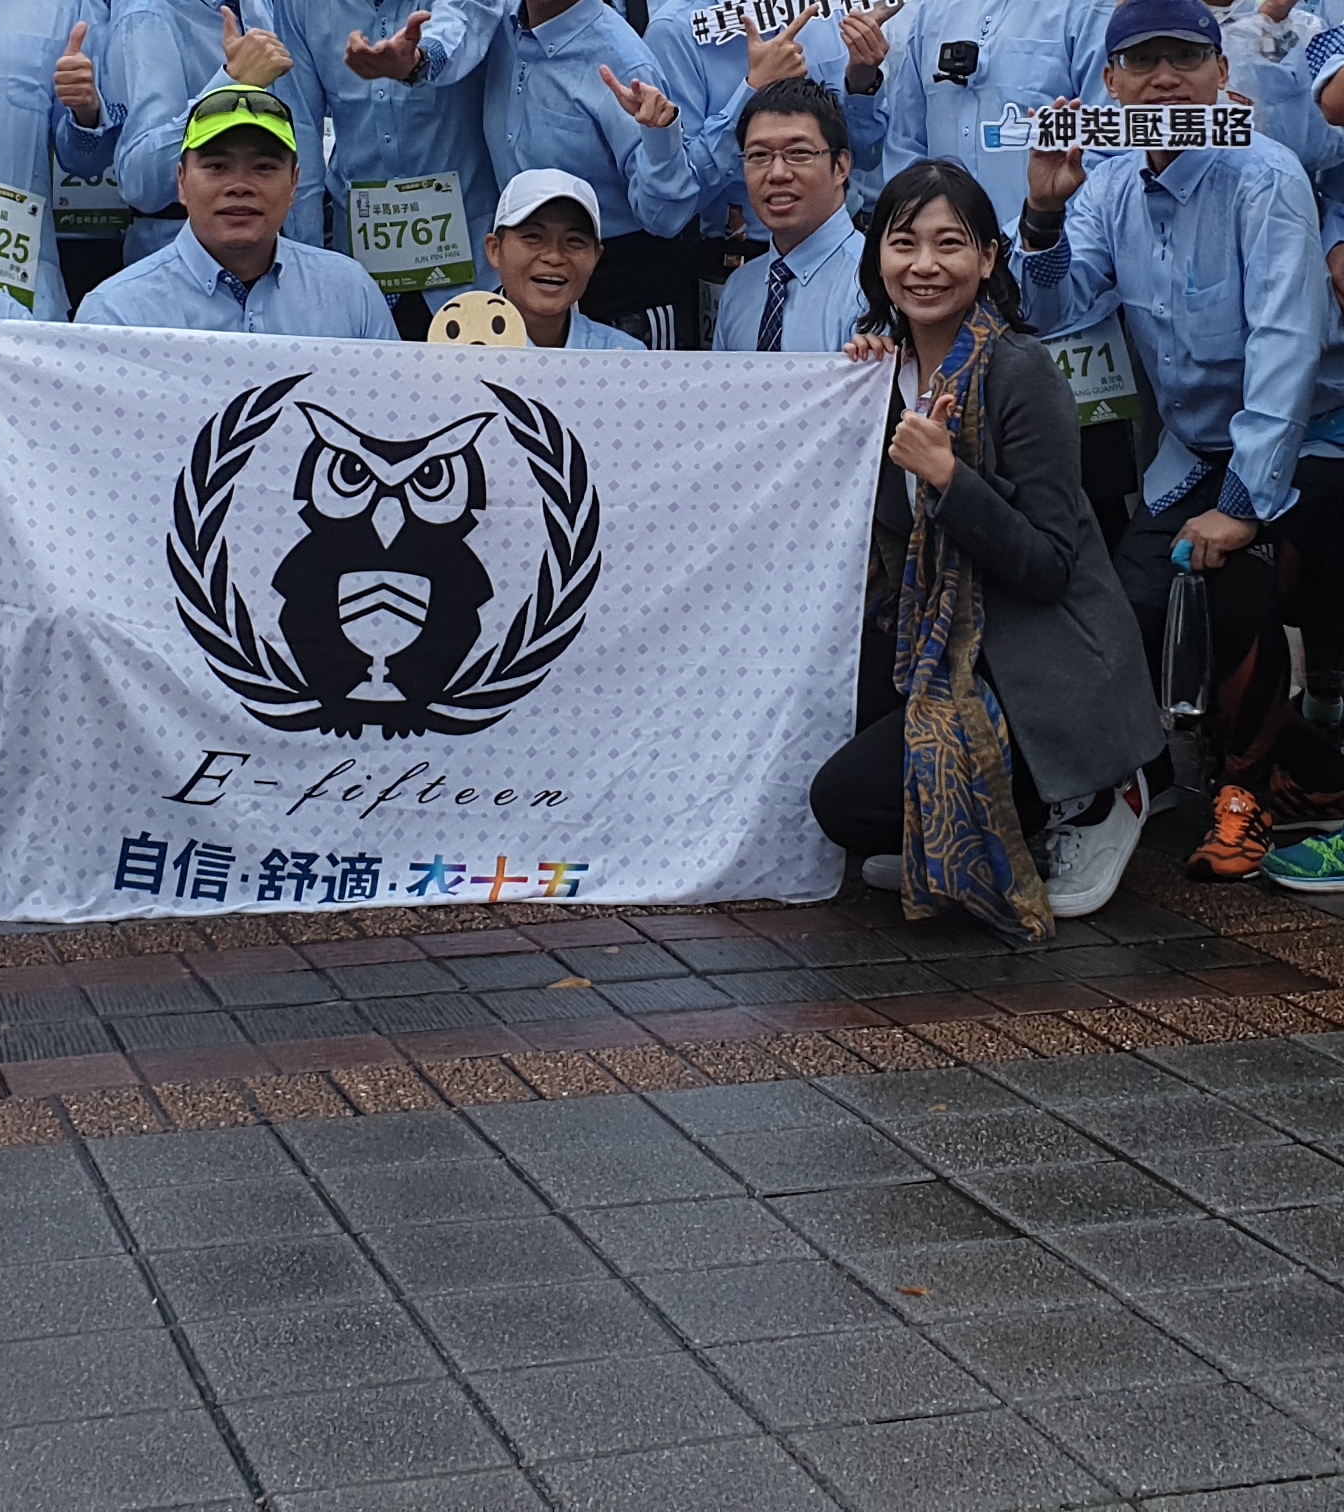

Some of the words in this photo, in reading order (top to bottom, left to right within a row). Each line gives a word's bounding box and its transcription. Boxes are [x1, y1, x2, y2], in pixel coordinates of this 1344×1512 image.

[1038, 107, 1251, 147] 紳裝壓馬路
[358, 213, 452, 250] 15767
